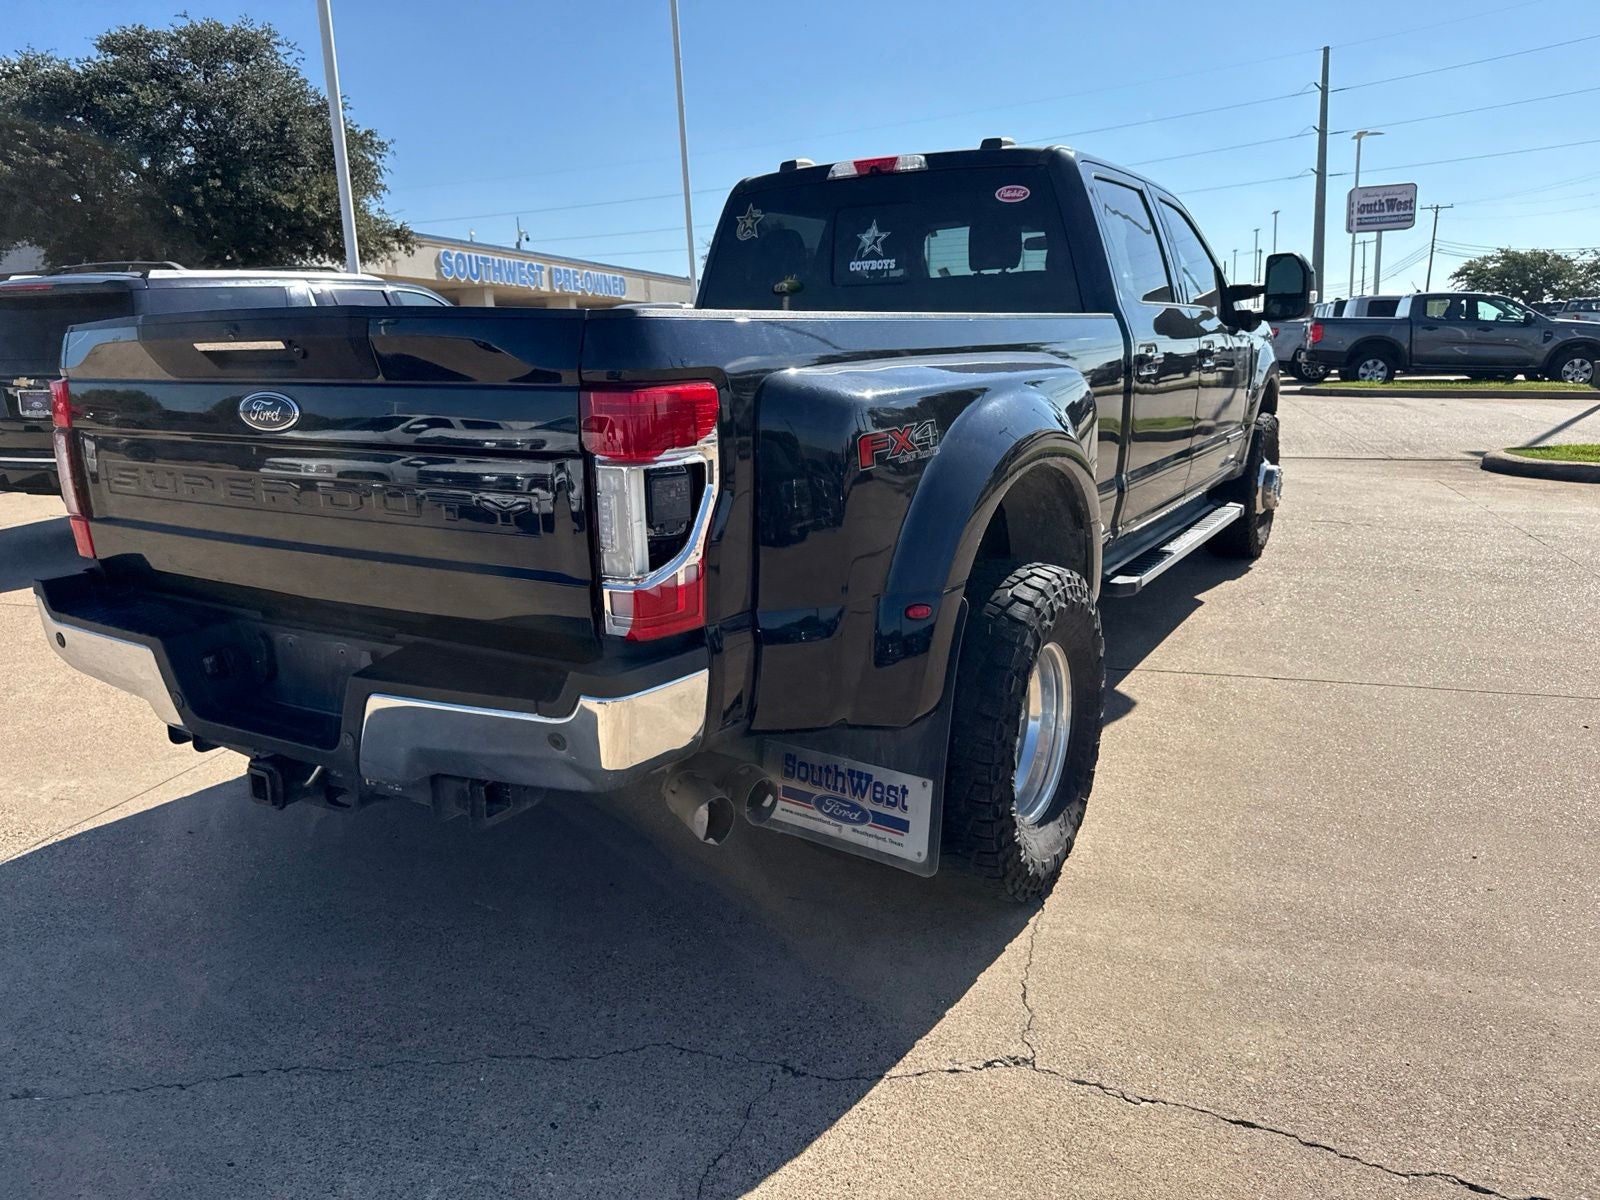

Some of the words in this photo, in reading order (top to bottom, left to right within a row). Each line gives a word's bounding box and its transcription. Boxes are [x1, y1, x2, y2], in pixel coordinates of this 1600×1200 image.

[440, 249, 546, 290] SOUTHWEST
[551, 266, 626, 298] PRE-OWNED
[849, 258, 896, 271] COWBOYS
[250, 399, 282, 422] Ford
[857, 419, 939, 472] FX4
[111, 465, 300, 504] SUPER
[317, 484, 535, 527] DUTY
[782, 751, 910, 813] SouthWest
[821, 797, 863, 822] Ford
